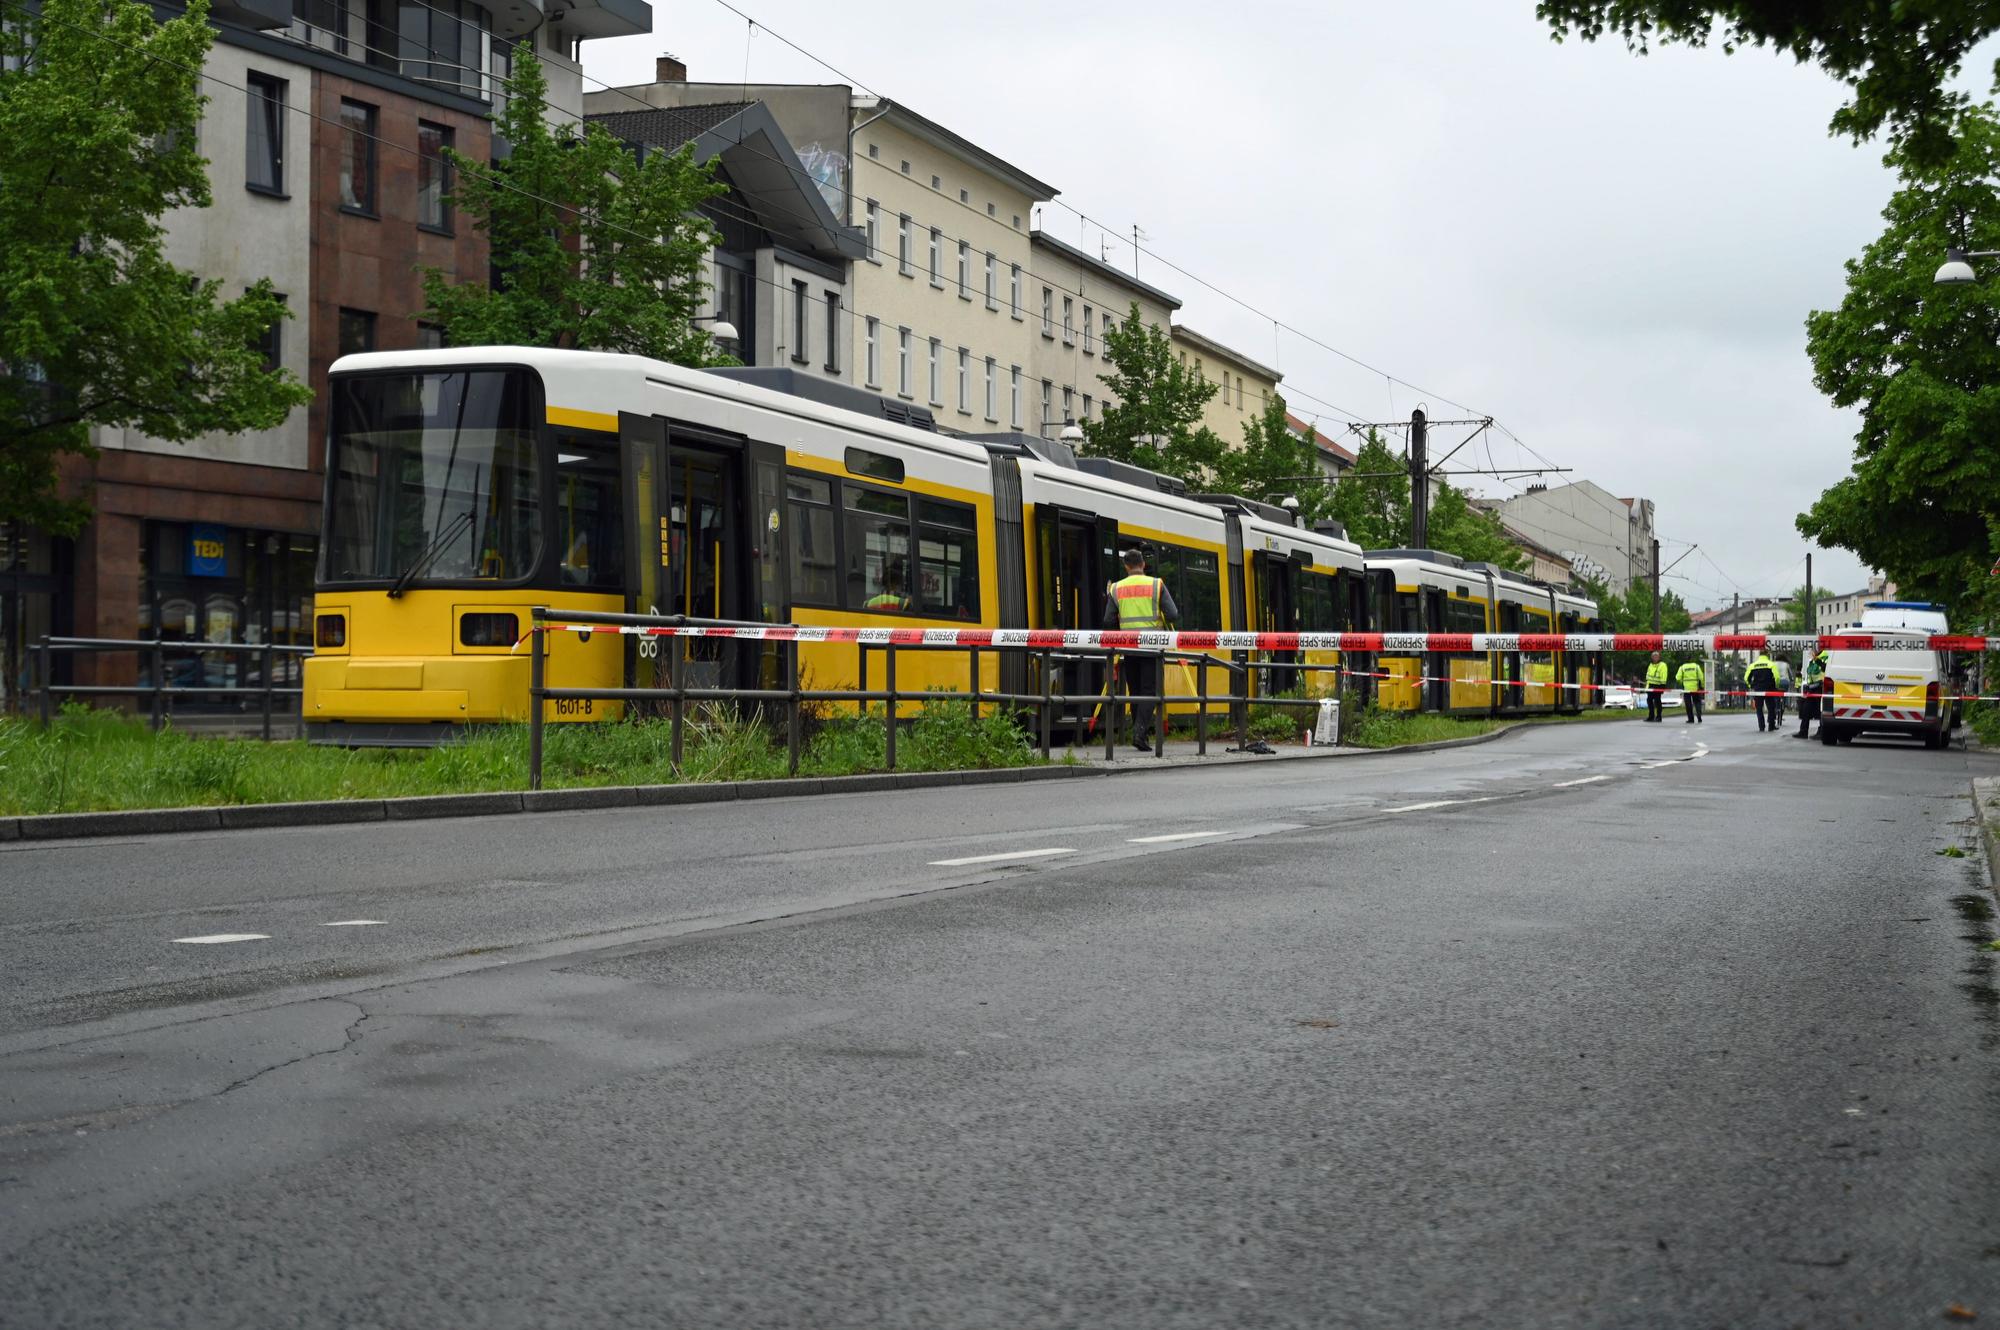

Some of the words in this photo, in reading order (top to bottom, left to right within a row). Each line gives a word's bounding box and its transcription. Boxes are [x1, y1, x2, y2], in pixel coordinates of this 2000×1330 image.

[193, 540, 225, 558] TEDi
[1001, 632, 1079, 645] FEUERWEHR-SPERRZONE
[1088, 633, 1169, 646] FEUERWEHR-SPERRZONE
[1180, 634, 1265, 648] FEUERWEHR-SPERRZONE
[1276, 635, 1366, 649] FEUERWEHR-SPERRZONE
[1378, 636, 1472, 650] FEUERWEHR-SPERRZONE
[1485, 637, 1585, 650] FEUERWEHR-SPERRZONE
[1599, 638, 1704, 651] FEUERWEHR-SPERRZONE
[555, 698, 592, 715] 1601-B
